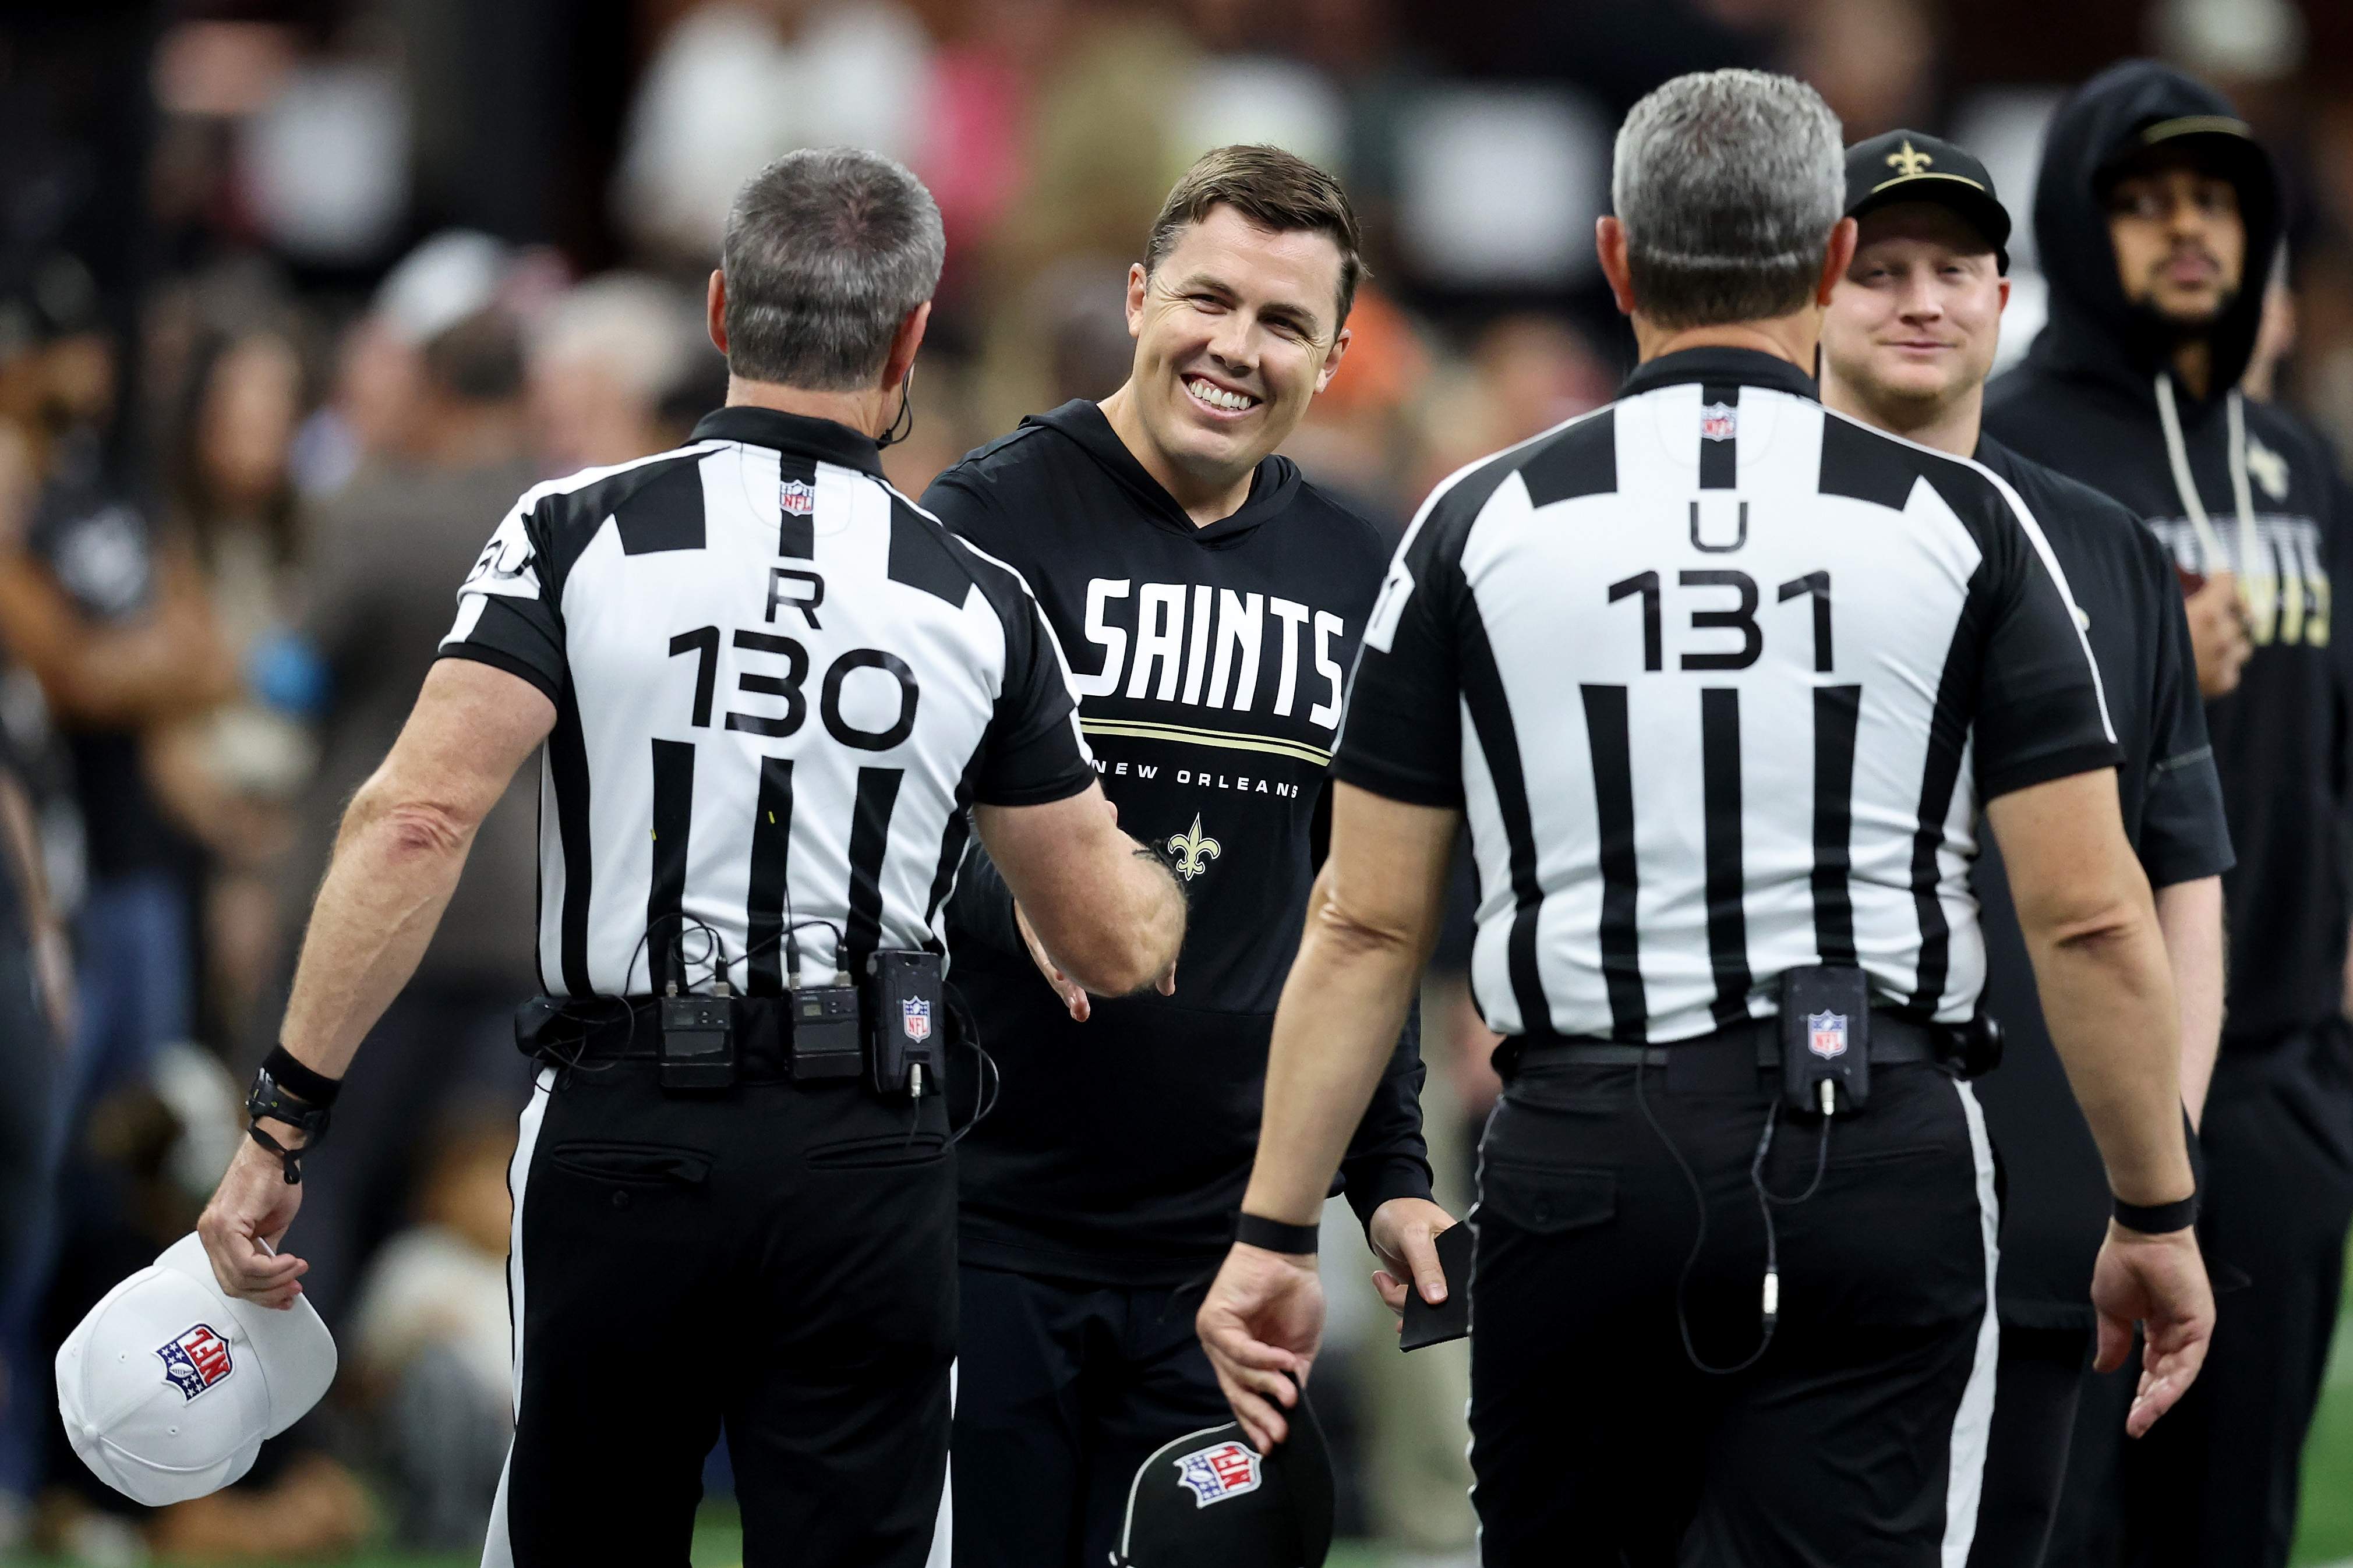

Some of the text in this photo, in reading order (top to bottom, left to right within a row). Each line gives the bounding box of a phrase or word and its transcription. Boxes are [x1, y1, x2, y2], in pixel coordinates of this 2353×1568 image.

[783, 494, 811, 511] NFL
[1690, 501, 1748, 553] U
[765, 567, 824, 629] R
[1608, 570, 1835, 672] 131
[1072, 578, 1343, 730] SAINTS
[669, 625, 919, 751] 130
[1091, 759, 1298, 798] NEW ORLEANS
[907, 1017, 928, 1035] NFL
[184, 1328, 231, 1386] NFL
[1211, 1446, 1251, 1489] NFL
